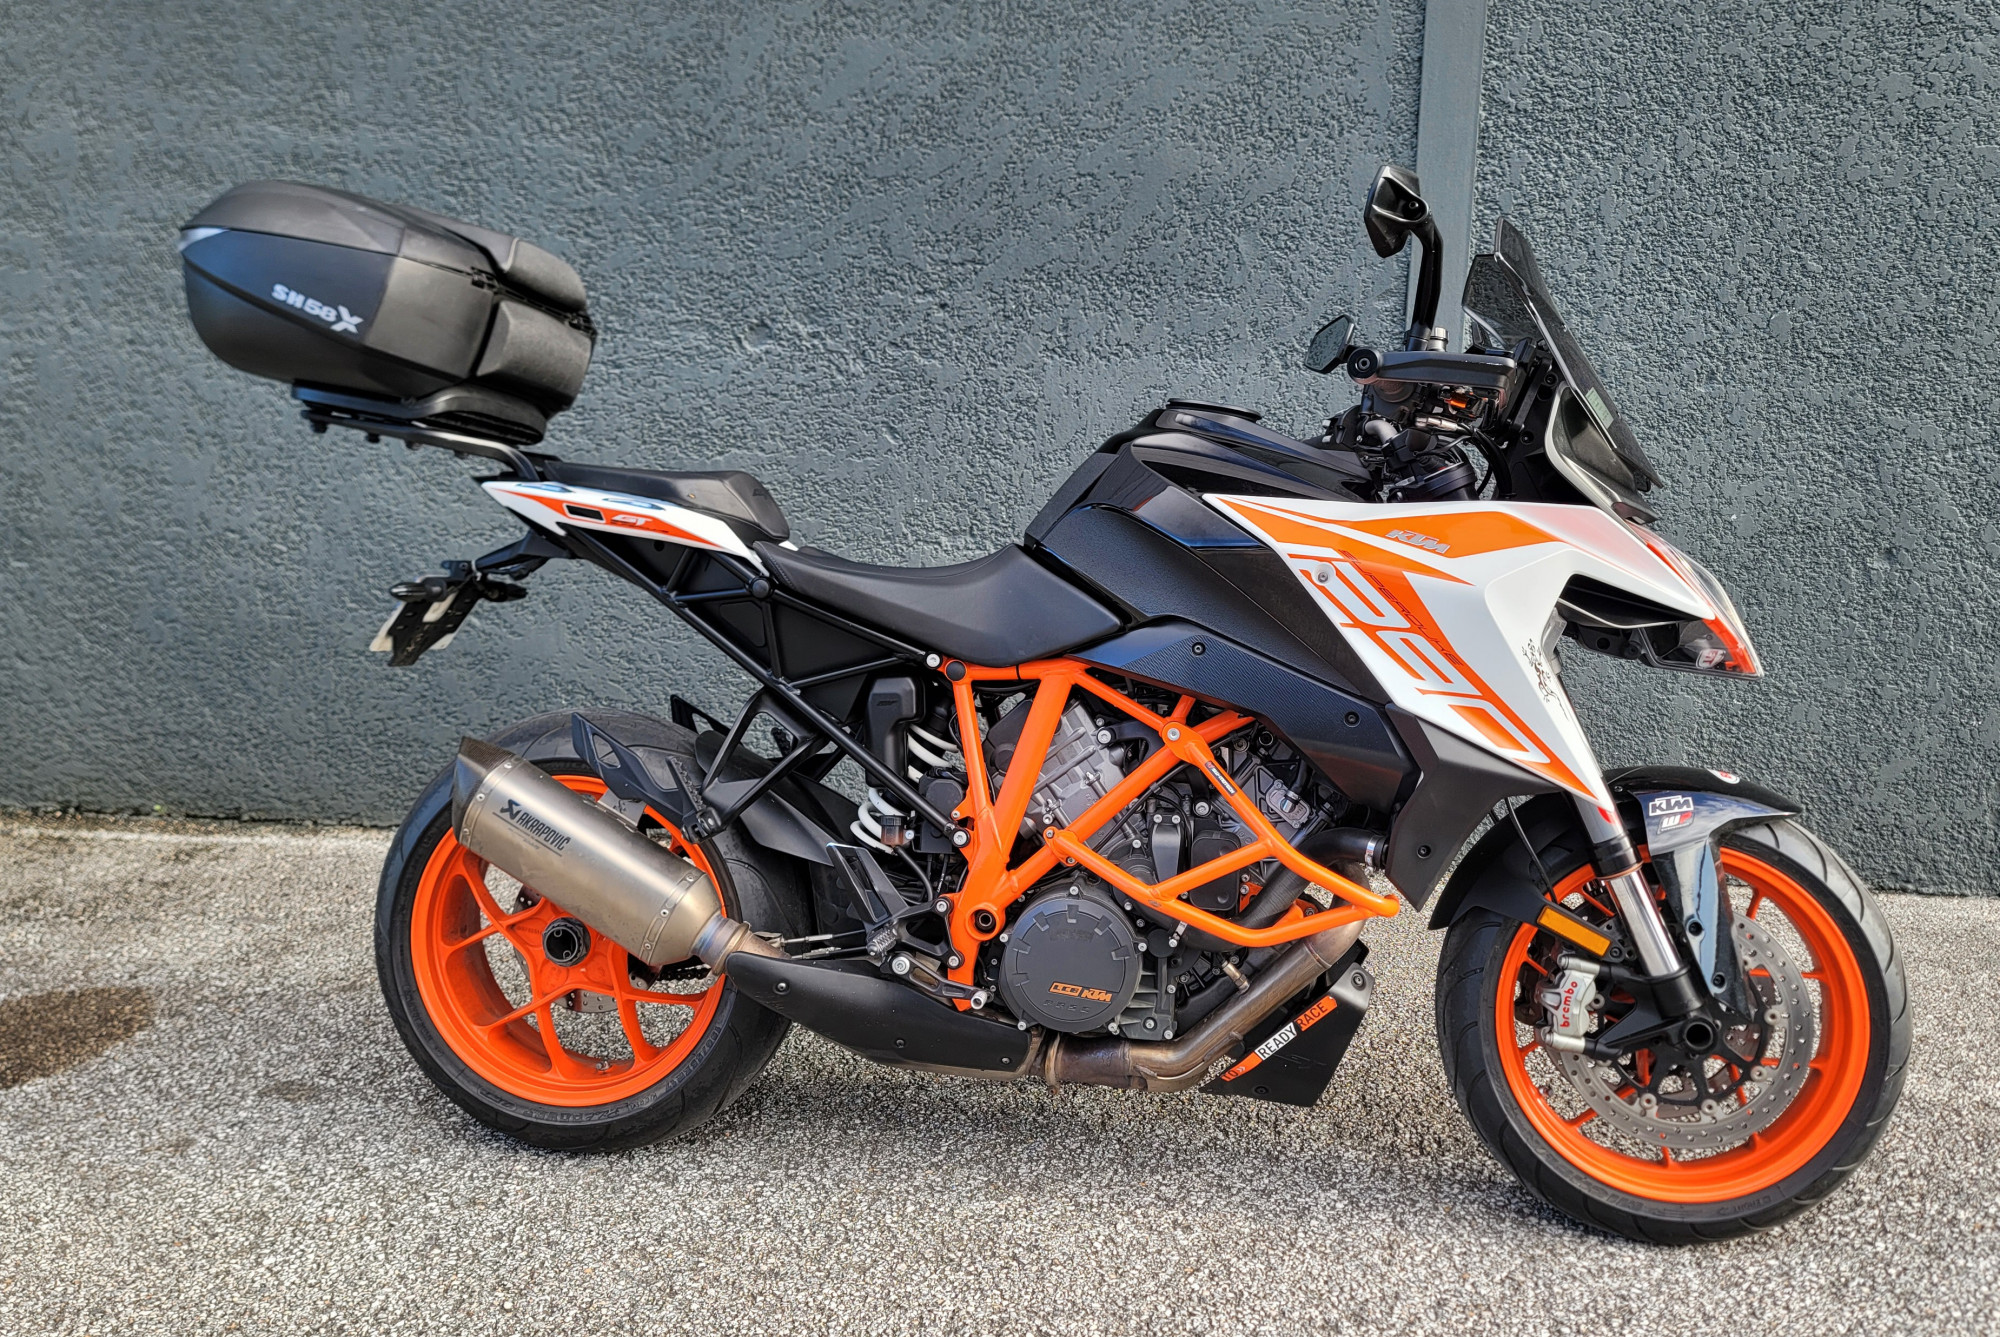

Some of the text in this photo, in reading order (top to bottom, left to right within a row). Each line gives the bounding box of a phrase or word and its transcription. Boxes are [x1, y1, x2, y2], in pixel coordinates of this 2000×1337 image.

[1385, 529, 1451, 555] KTM
[1650, 796, 1693, 815] KTM
[1081, 988, 1112, 1002] KTM
[1560, 981, 1578, 1028] brembo
[1257, 1024, 1297, 1059] READY
[1296, 1002, 1328, 1028] RACE
